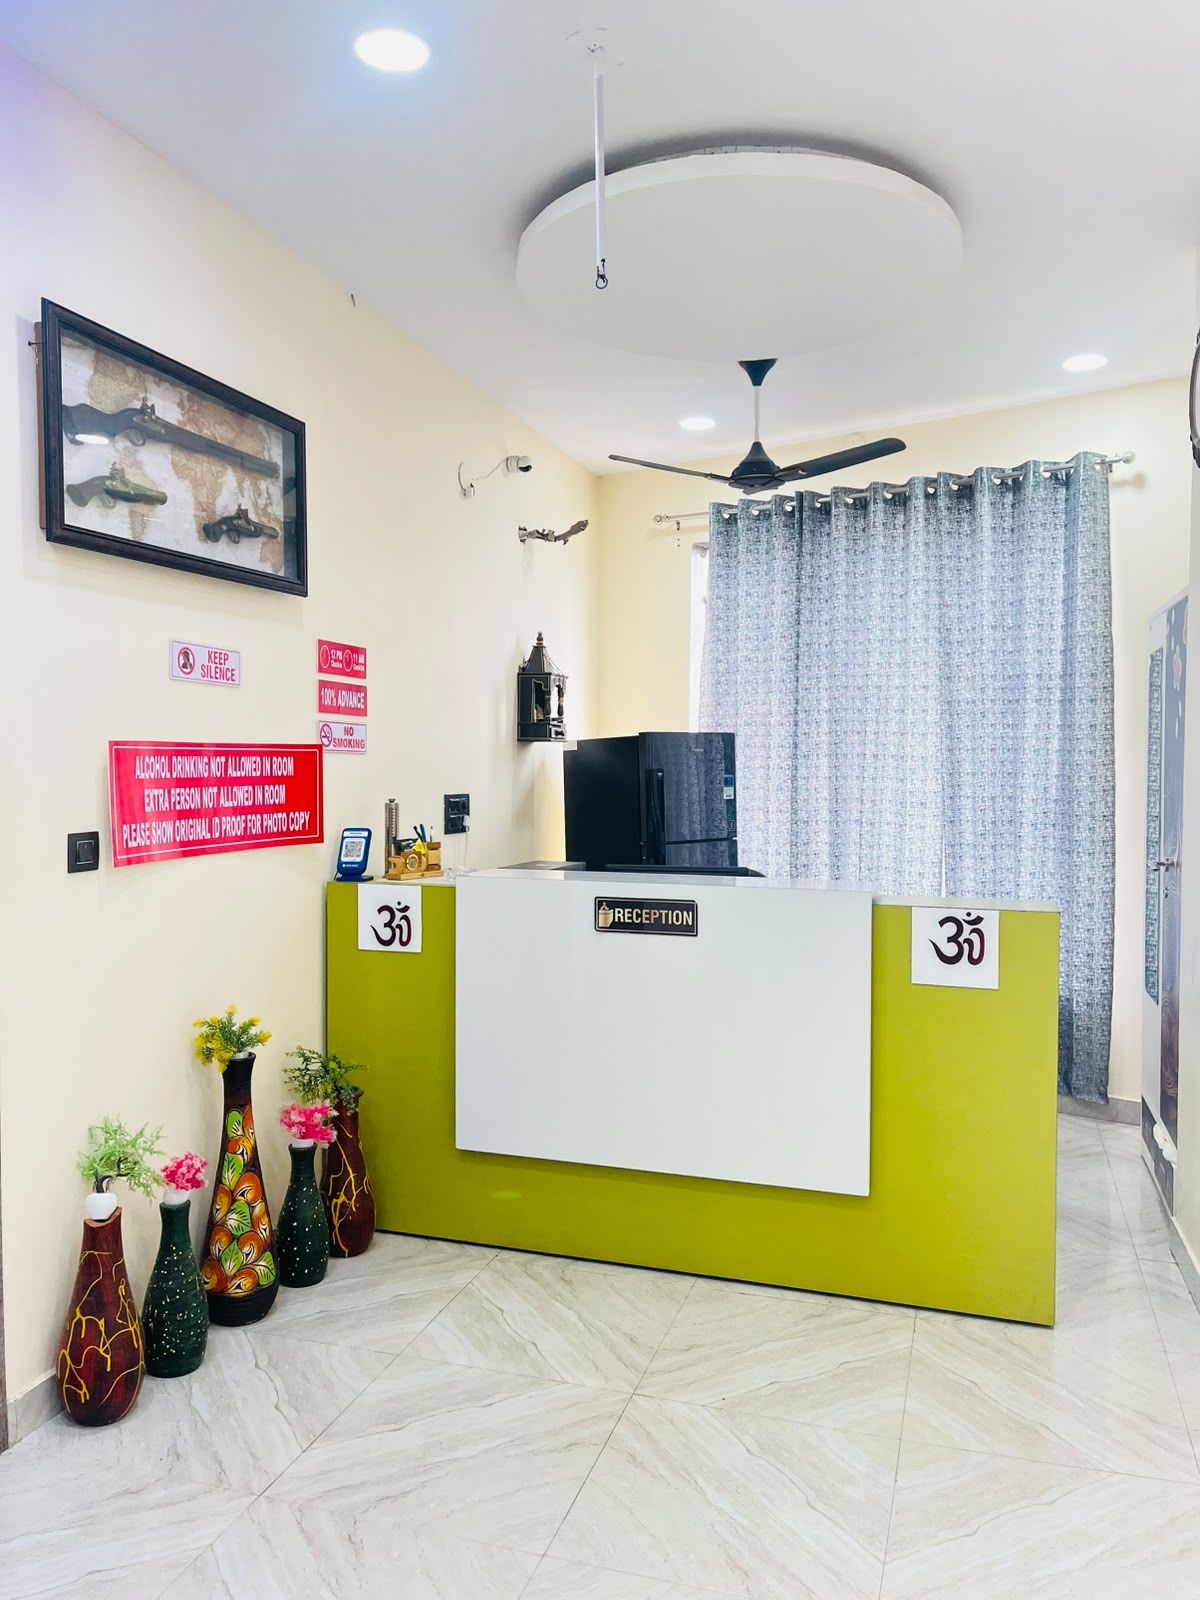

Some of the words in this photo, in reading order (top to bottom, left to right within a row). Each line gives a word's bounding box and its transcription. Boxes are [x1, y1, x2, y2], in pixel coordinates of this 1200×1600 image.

[207, 650, 229, 666] KEEP
[200, 664, 236, 682] SILENCE
[321, 687, 337, 707] 100%
[337, 689, 365, 709] ADVANCE
[343, 726, 354, 737] NO
[332, 737, 366, 749] SMOKING
[135, 755, 171, 779] ALCOHOL
[171, 755, 209, 779] DRINKING
[210, 755, 226, 778] NOT
[227, 755, 261, 777] ALLOWED
[262, 756, 271, 777] IN
[272, 756, 294, 777] ROOM
[144, 788, 170, 813] EXTRA
[170, 787, 201, 811] PERSON
[202, 786, 218, 809] NOT
[219, 785, 253, 808] ALLOWED
[254, 784, 263, 806] IN
[264, 783, 286, 805] ROOM
[122, 822, 150, 849] PLEASE
[151, 820, 174, 845] SHOW
[175, 817, 211, 842] ORIGINAL
[211, 816, 220, 839] ID
[221, 814, 246, 838] PROOF
[247, 813, 262, 835] FOR
[262, 811, 288, 834] PHOTO
[288, 810, 311, 832] COPY
[614, 907, 693, 926] RECEPTION
